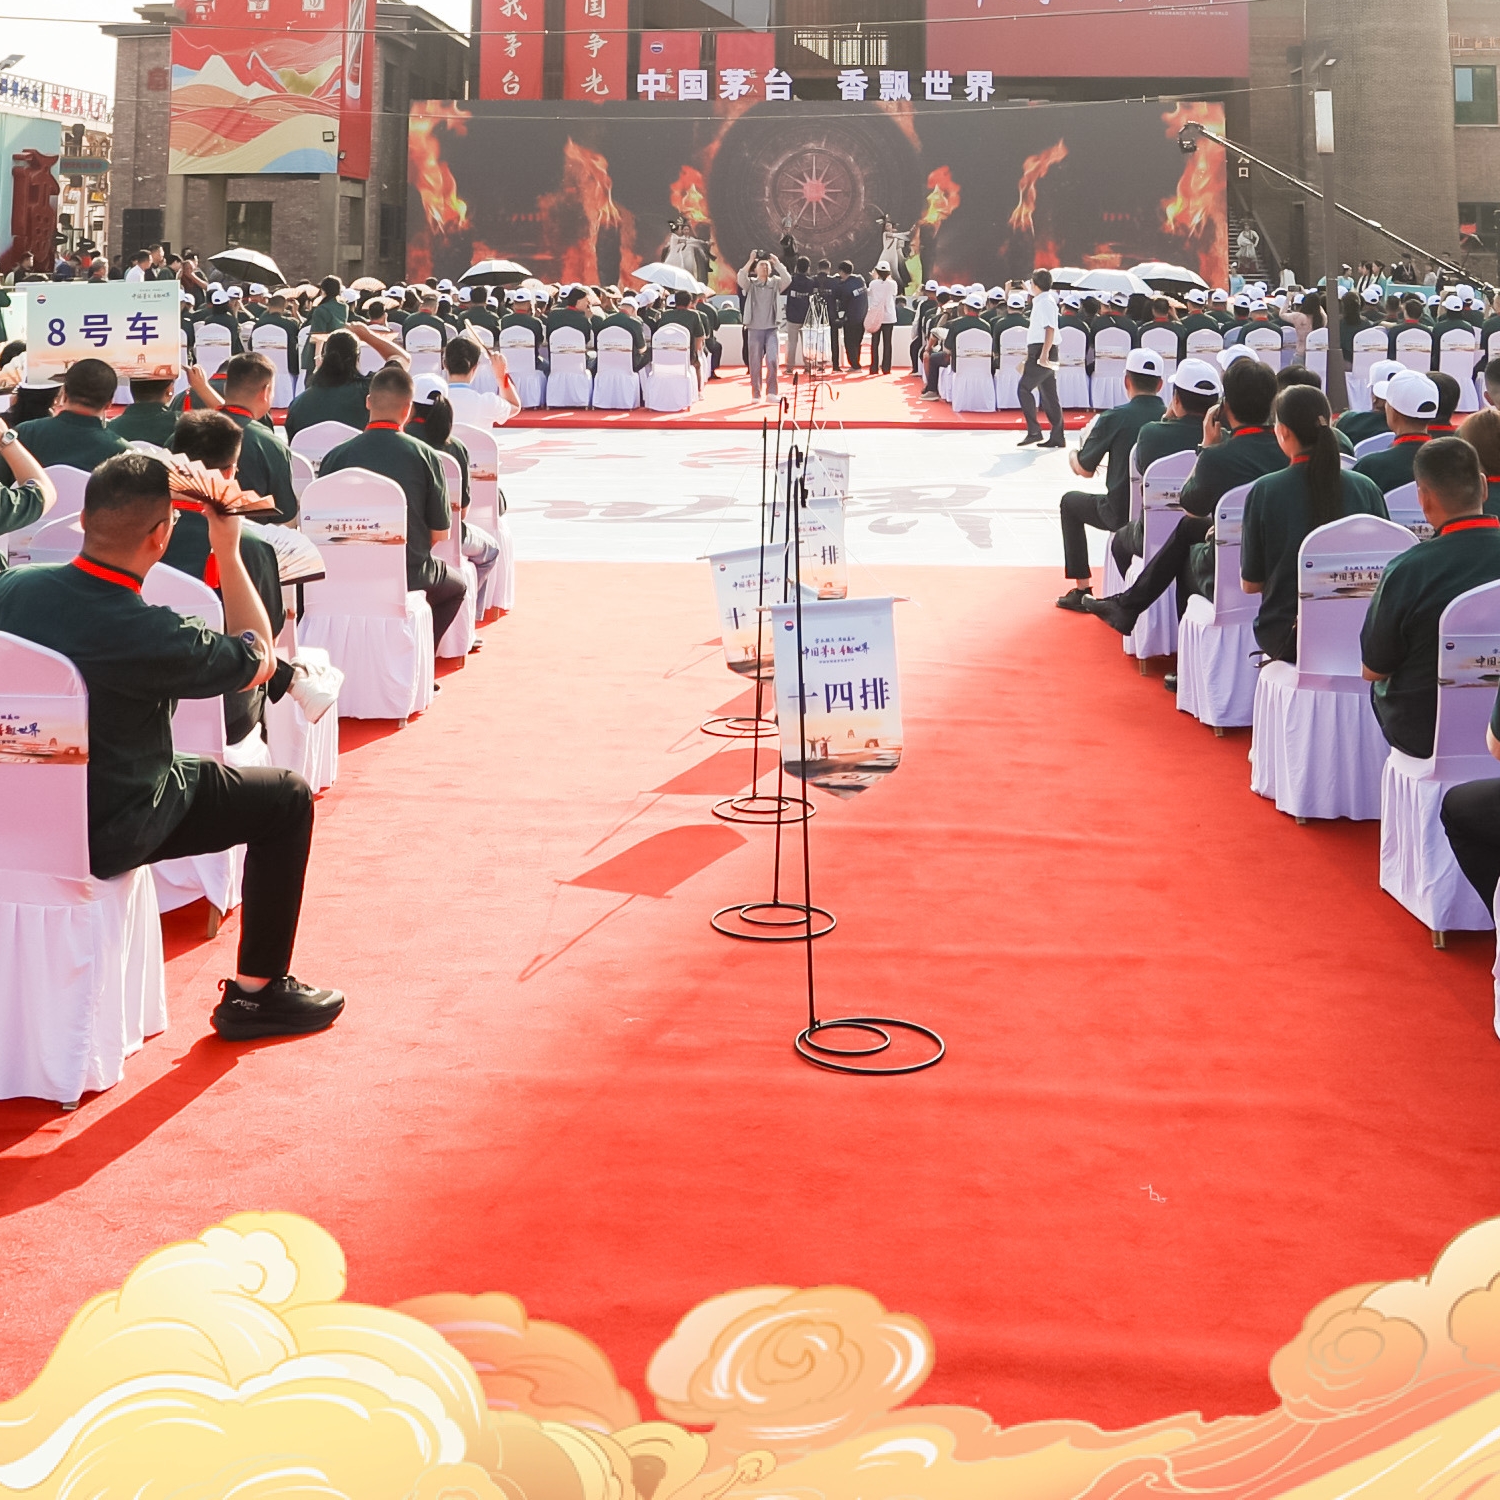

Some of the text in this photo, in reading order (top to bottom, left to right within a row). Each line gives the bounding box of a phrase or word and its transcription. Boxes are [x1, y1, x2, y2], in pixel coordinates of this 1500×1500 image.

[636, 67, 996, 102] 中国茅台 香飘世界
[47, 311, 160, 348] 8号车
